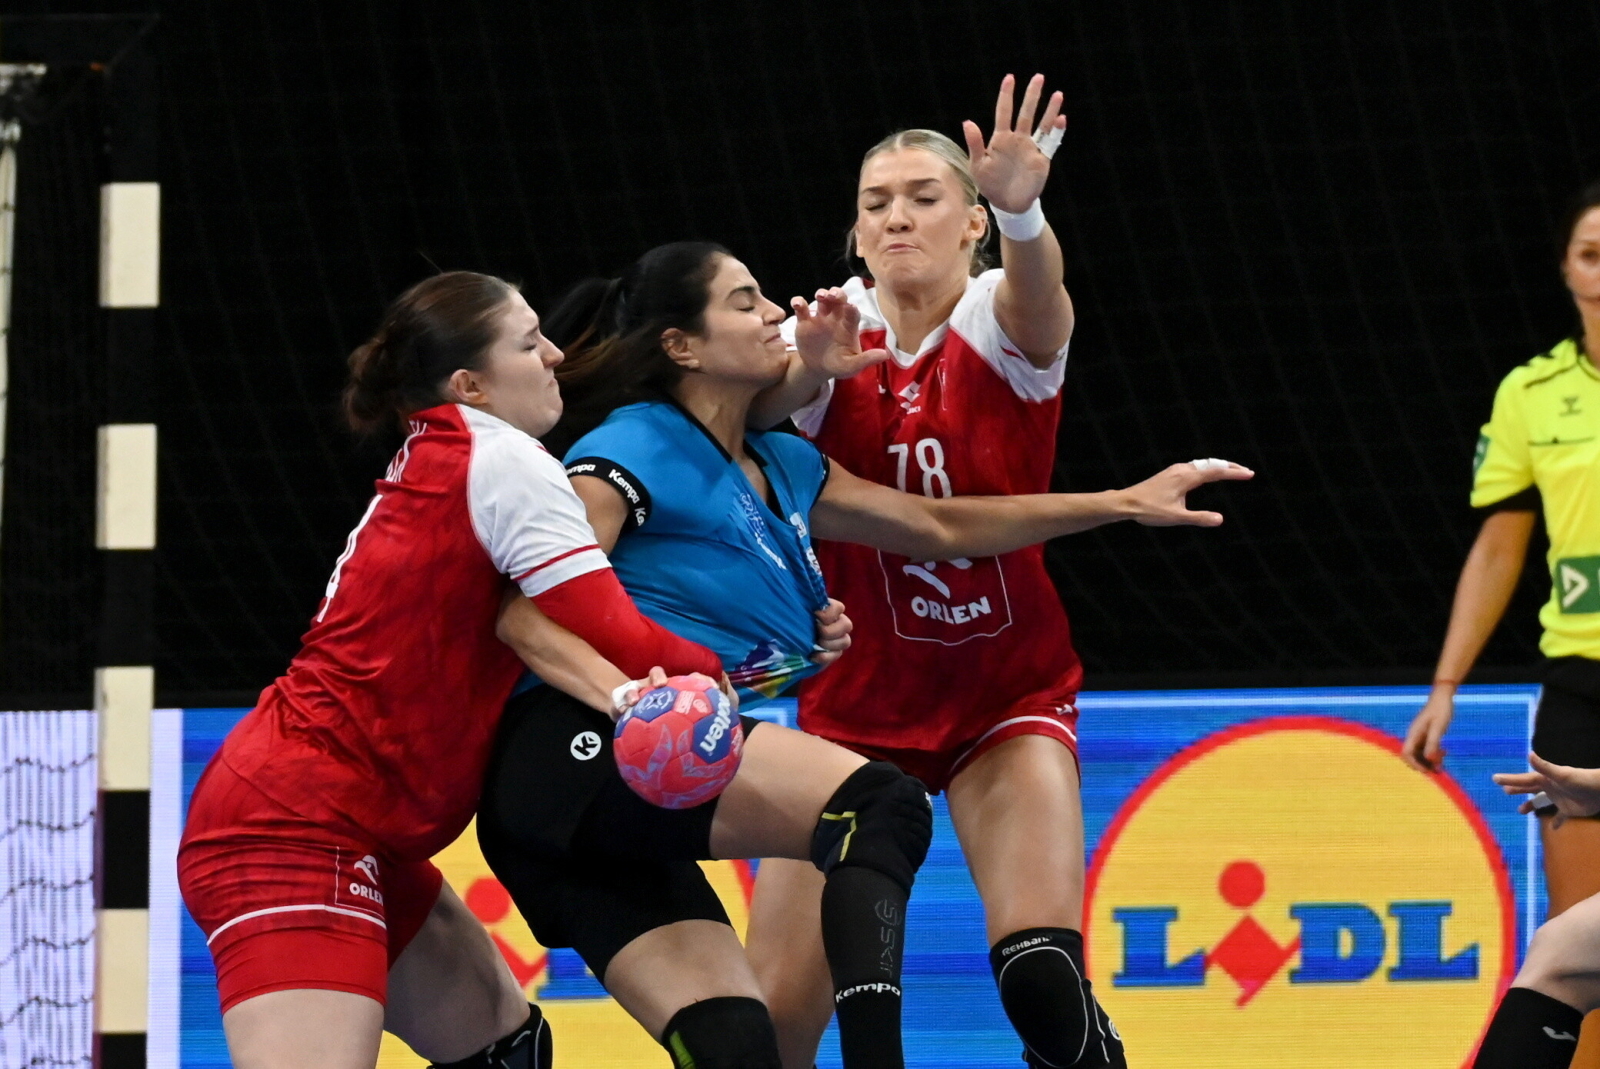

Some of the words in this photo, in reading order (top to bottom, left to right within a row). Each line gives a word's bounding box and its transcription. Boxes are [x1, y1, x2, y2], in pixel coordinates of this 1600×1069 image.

[566, 463, 596, 475] mpa
[887, 437, 952, 499] 78
[608, 469, 641, 504] Kempa
[911, 595, 992, 625] ORLEN
[835, 982, 901, 1003] Kempa
